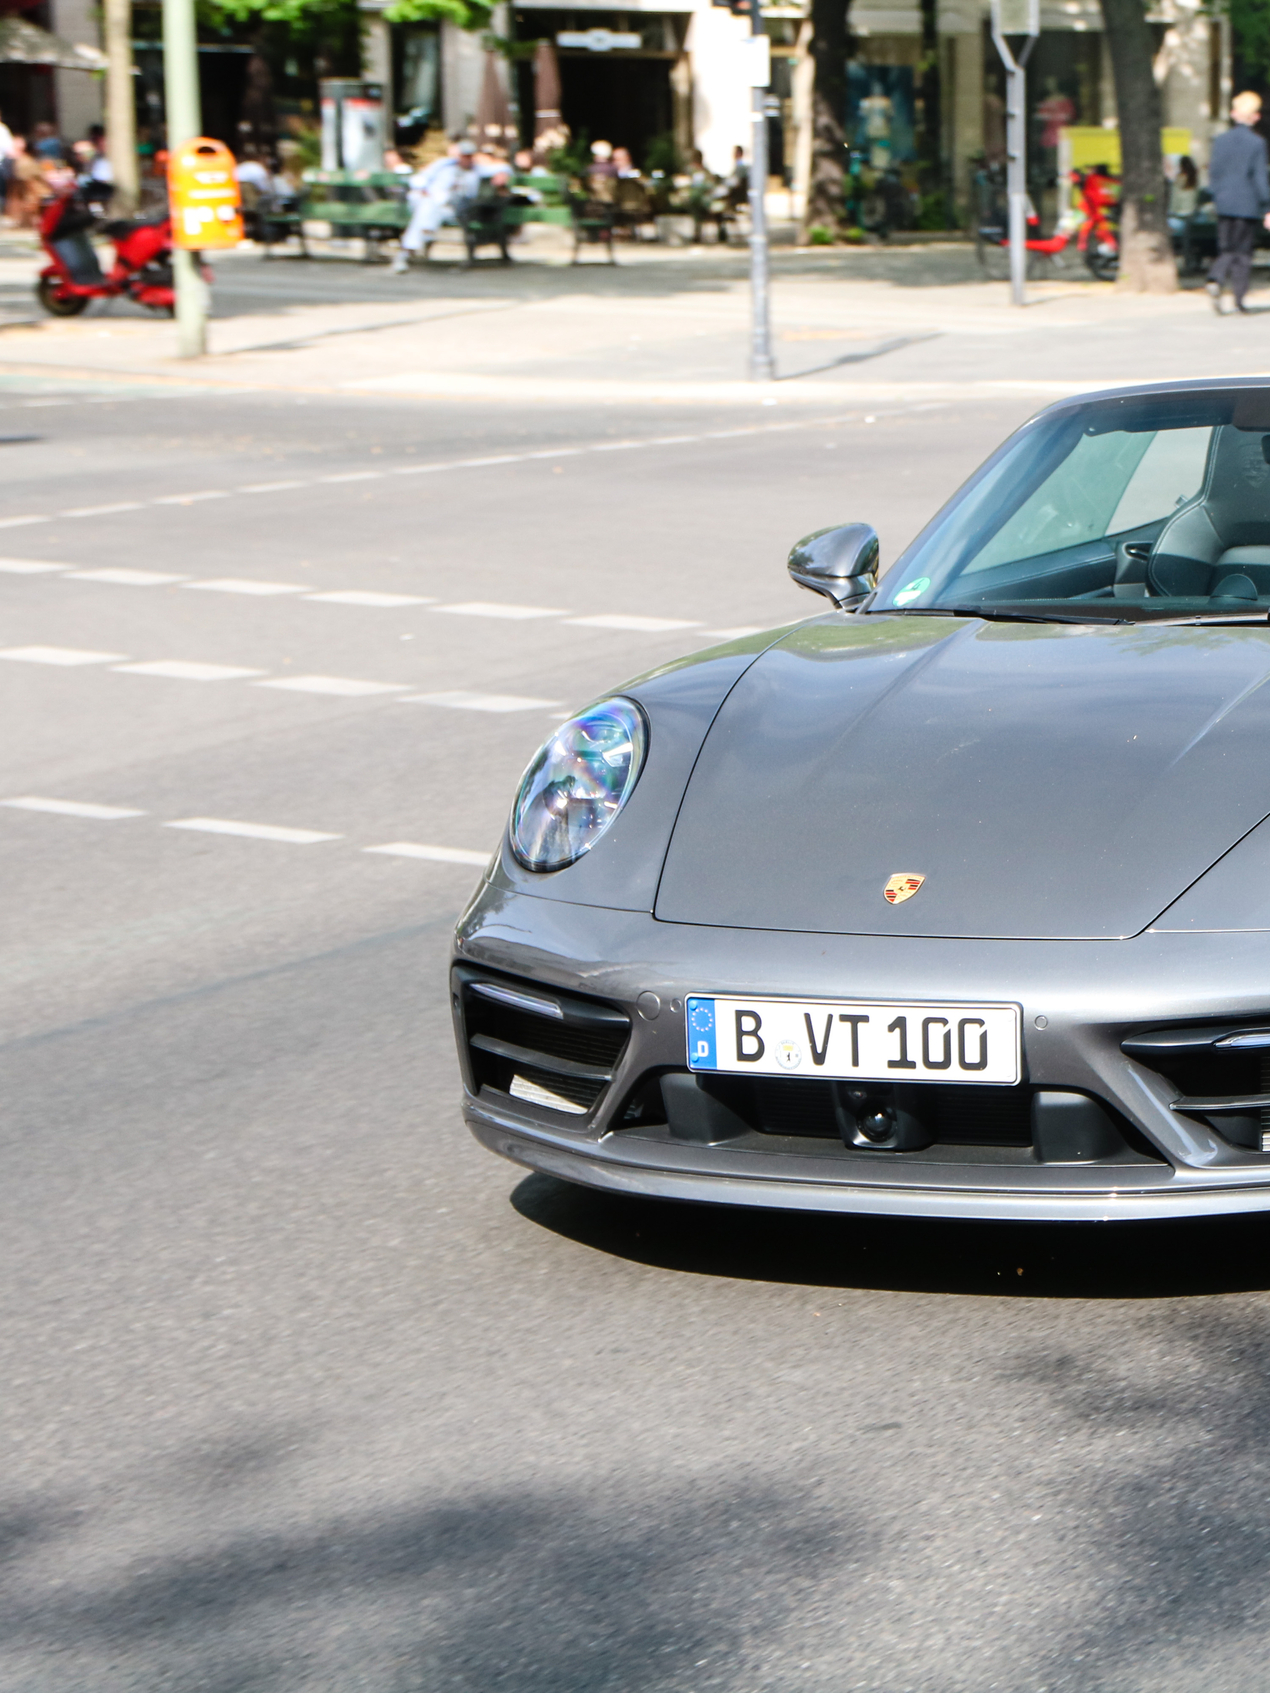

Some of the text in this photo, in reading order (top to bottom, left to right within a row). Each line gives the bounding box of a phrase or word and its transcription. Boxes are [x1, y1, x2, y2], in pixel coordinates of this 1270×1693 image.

[697, 1040, 709, 1058] D
[734, 1009, 765, 1062] B
[803, 1012, 870, 1067] VT
[887, 1015, 988, 1070] 100
